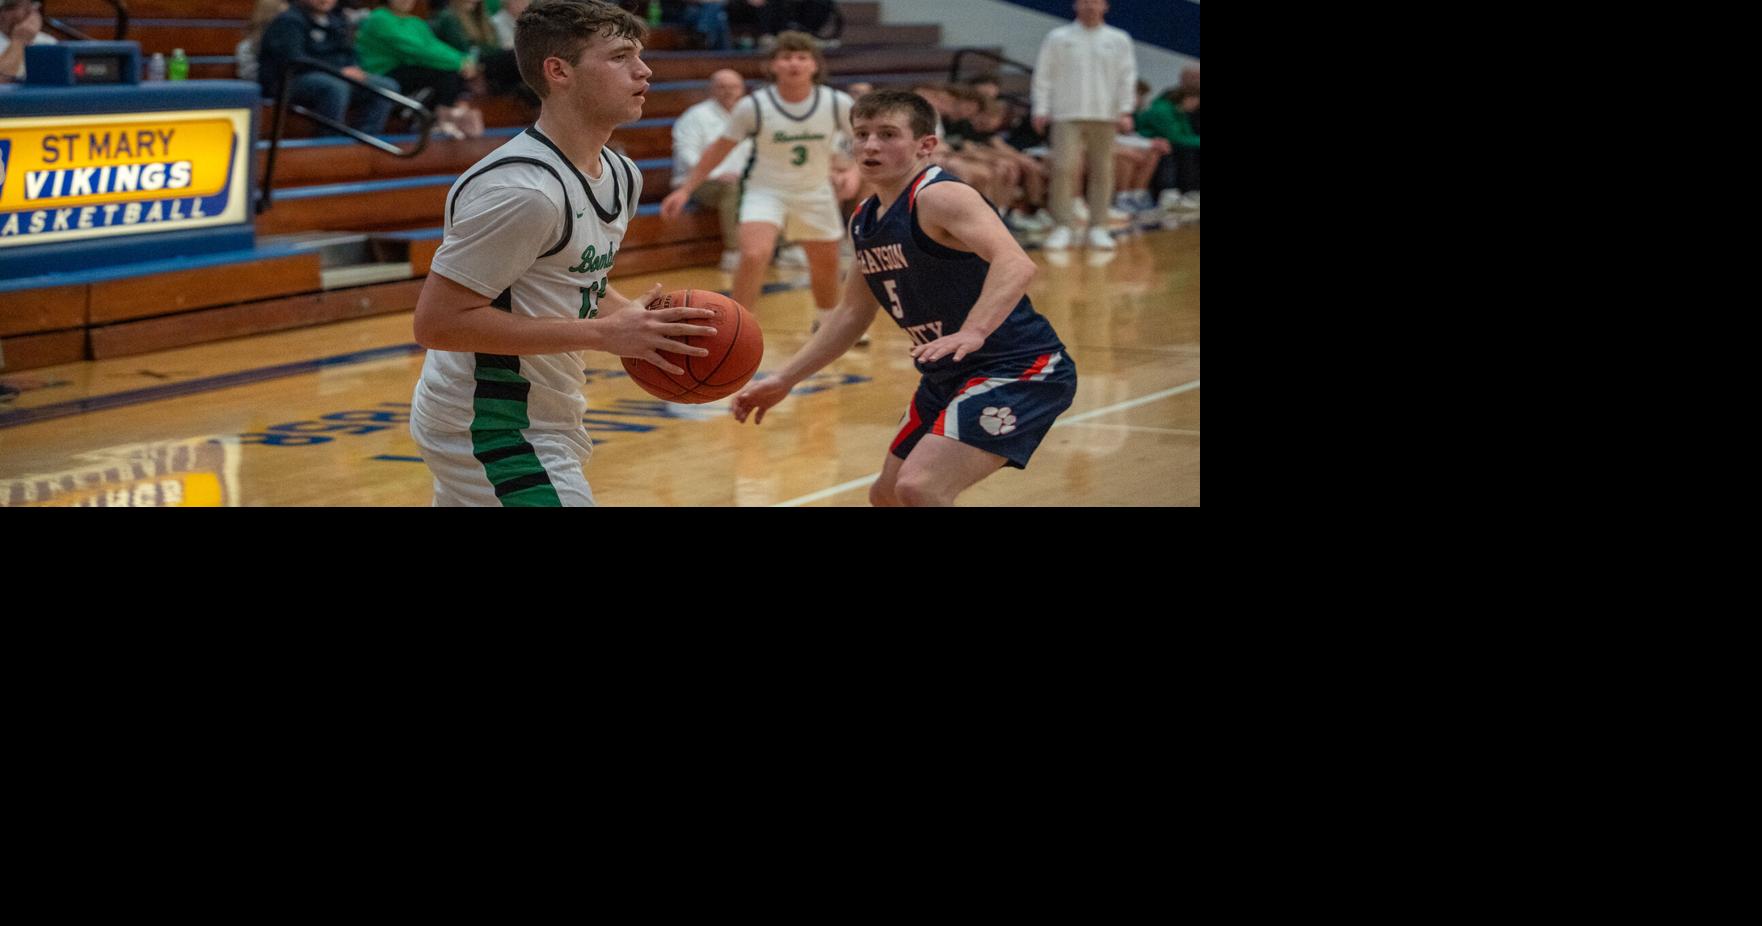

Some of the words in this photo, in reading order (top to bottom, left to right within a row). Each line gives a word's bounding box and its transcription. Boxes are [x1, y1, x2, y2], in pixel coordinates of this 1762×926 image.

[42, 134, 80, 164] ST
[89, 128, 175, 160] MARY
[792, 145, 807, 166] 3
[25, 160, 192, 200] VIKINGS
[883, 279, 904, 319] 5
